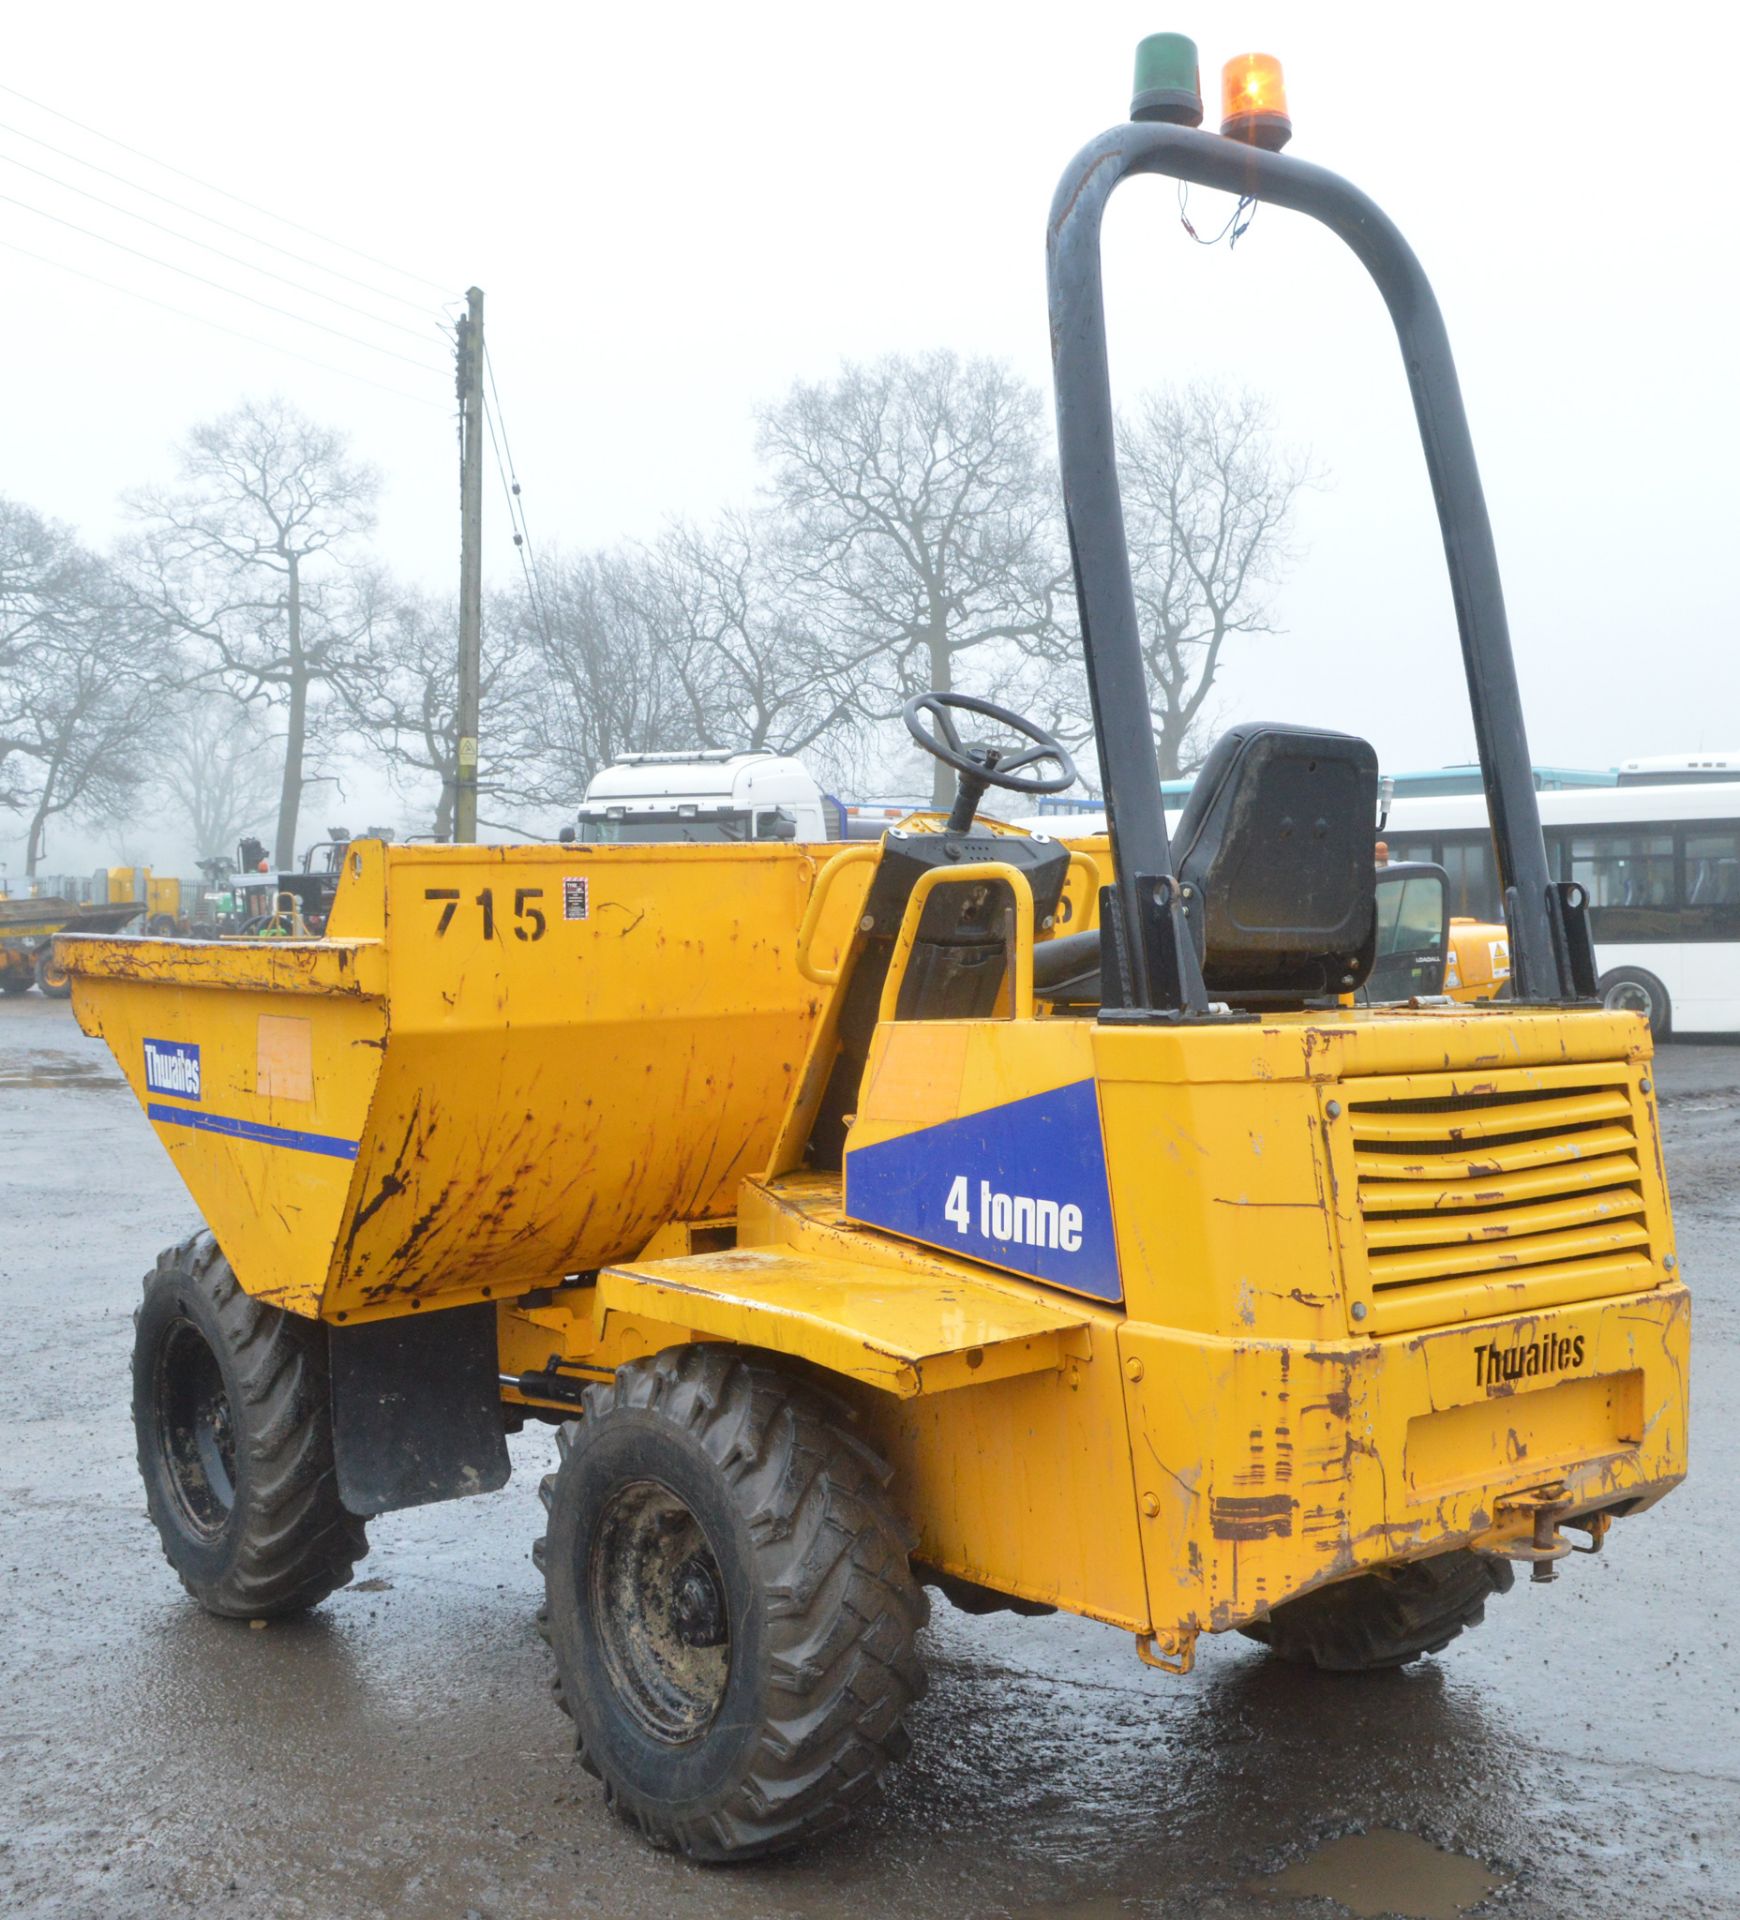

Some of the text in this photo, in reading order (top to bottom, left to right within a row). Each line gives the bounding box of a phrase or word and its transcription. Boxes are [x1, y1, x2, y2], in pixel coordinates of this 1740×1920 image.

[424, 887, 546, 942] 715
[144, 1044, 199, 1094] Thwaites
[945, 1175, 1083, 1252] 4 tonne
[1474, 1333, 1585, 1387] Thwaites
